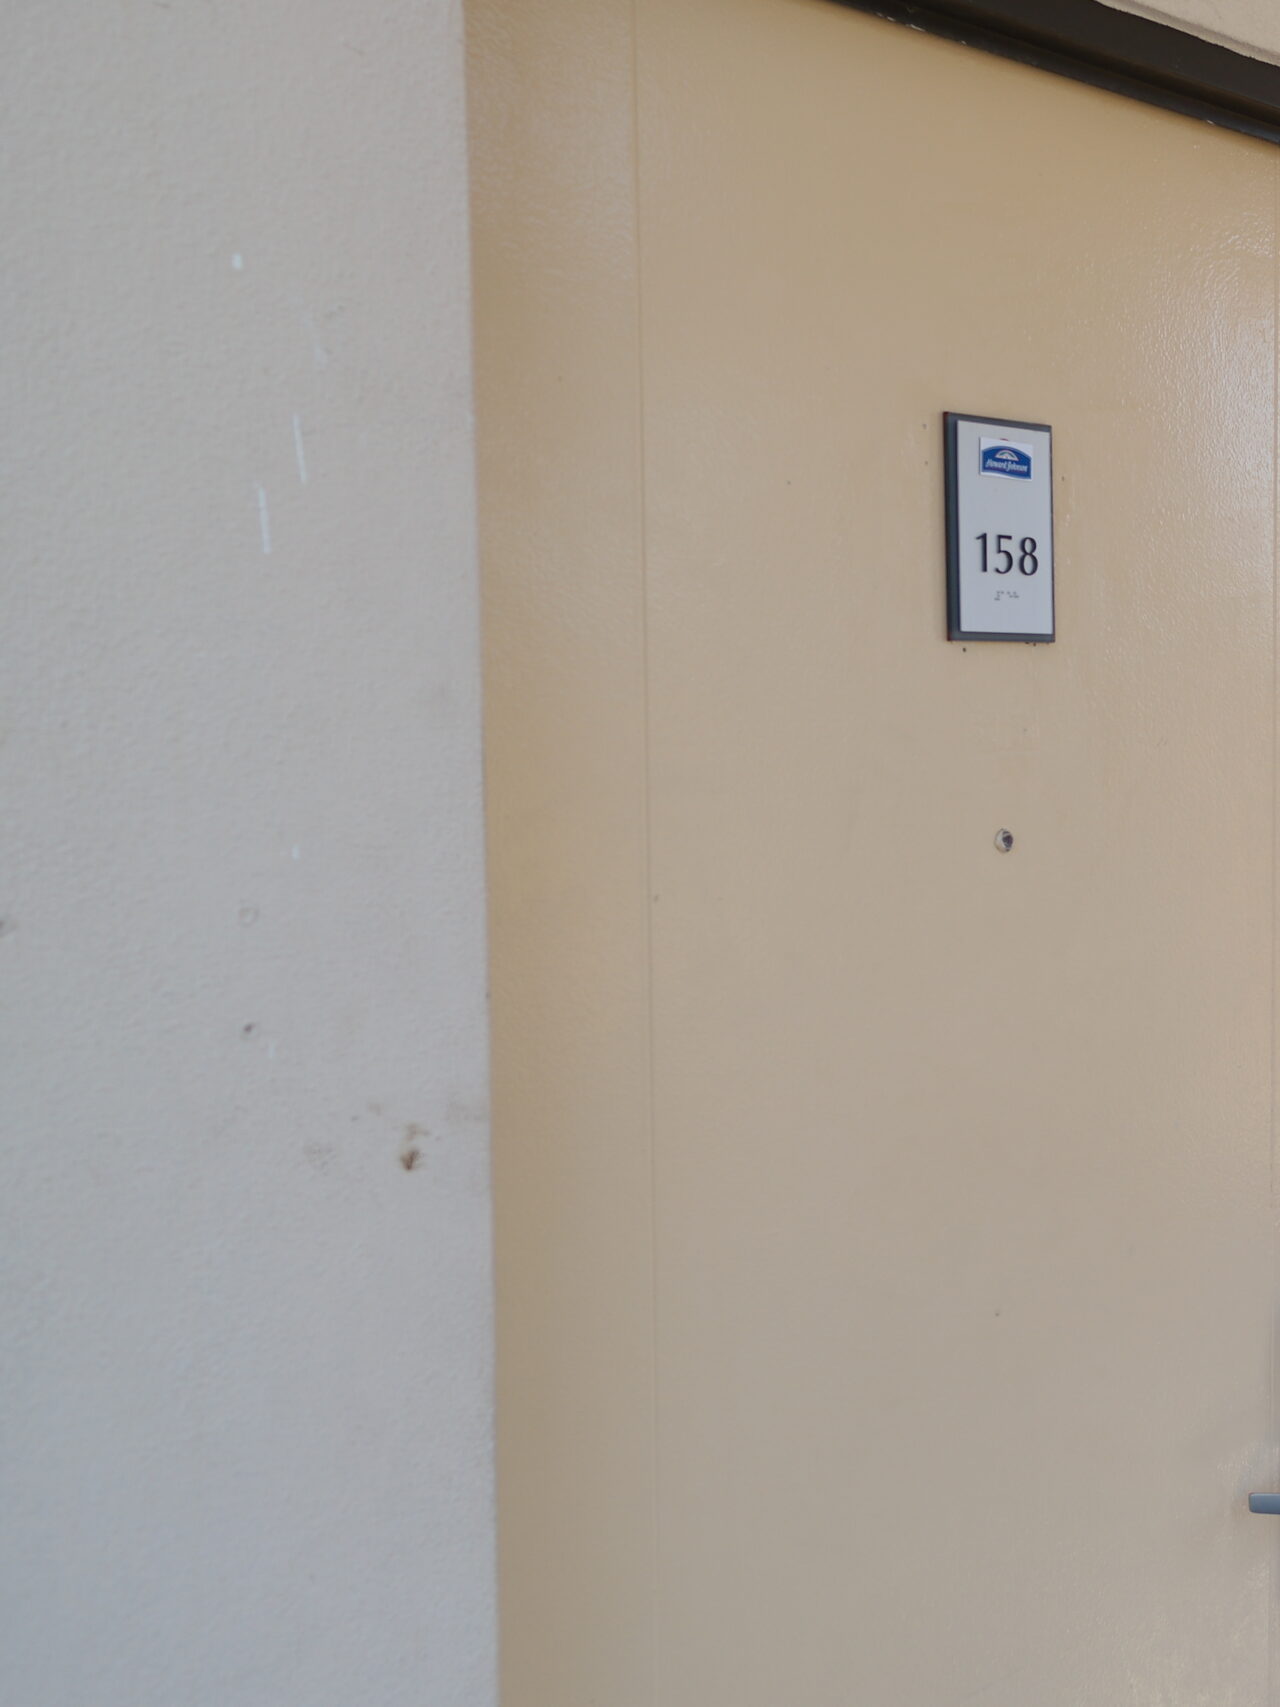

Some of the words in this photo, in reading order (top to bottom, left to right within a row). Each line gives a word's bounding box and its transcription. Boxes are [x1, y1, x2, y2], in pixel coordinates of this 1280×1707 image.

[985, 458, 1007, 469] Howard
[1006, 461, 1028, 472] Johnson
[975, 532, 1039, 576] 158
